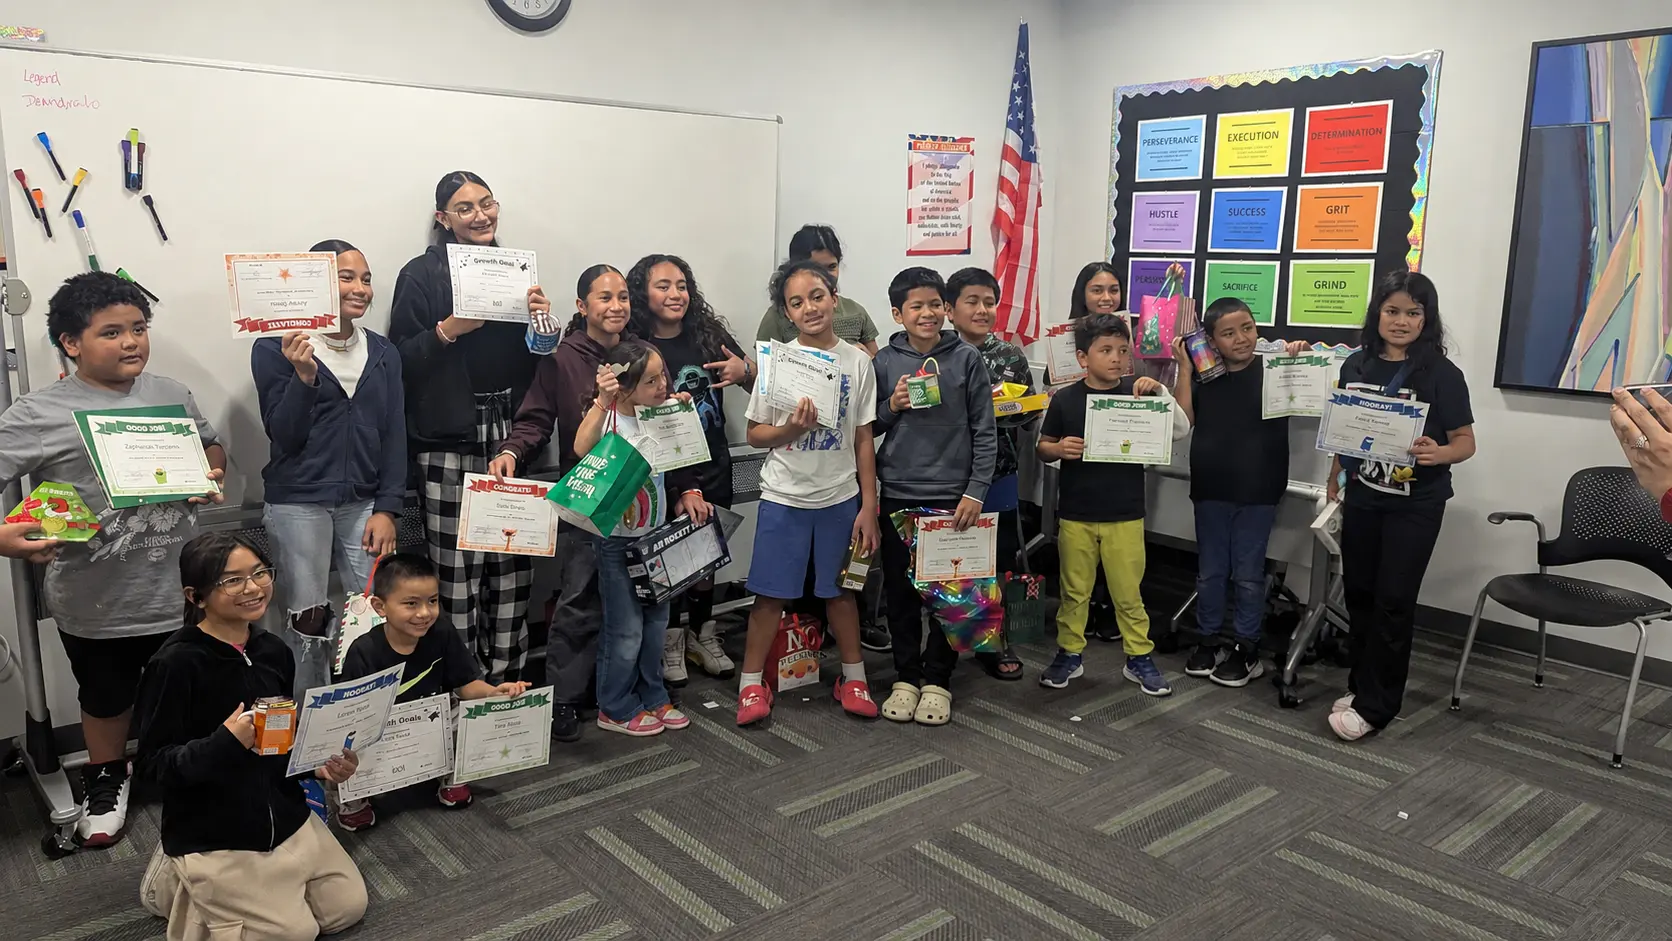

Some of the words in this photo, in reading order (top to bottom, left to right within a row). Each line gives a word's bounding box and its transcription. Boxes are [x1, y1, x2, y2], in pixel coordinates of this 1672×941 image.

[1228, 131, 1279, 142] EXECUTION
[1312, 128, 1382, 140] DETERMINATION
[1143, 135, 1198, 147] PERSEVERANCE
[1149, 210, 1179, 218] HUSTLE
[1228, 208, 1266, 216] SUCCESS
[1326, 205, 1350, 214] GRIT
[1222, 282, 1258, 291] SACRIFICE
[1314, 280, 1347, 289] GRIND
[1360, 400, 1392, 411] HOORAY!
[343, 682, 376, 698] HOORAY!
[491, 703, 510, 711] GOOD
[399, 715, 422, 724] Goals
